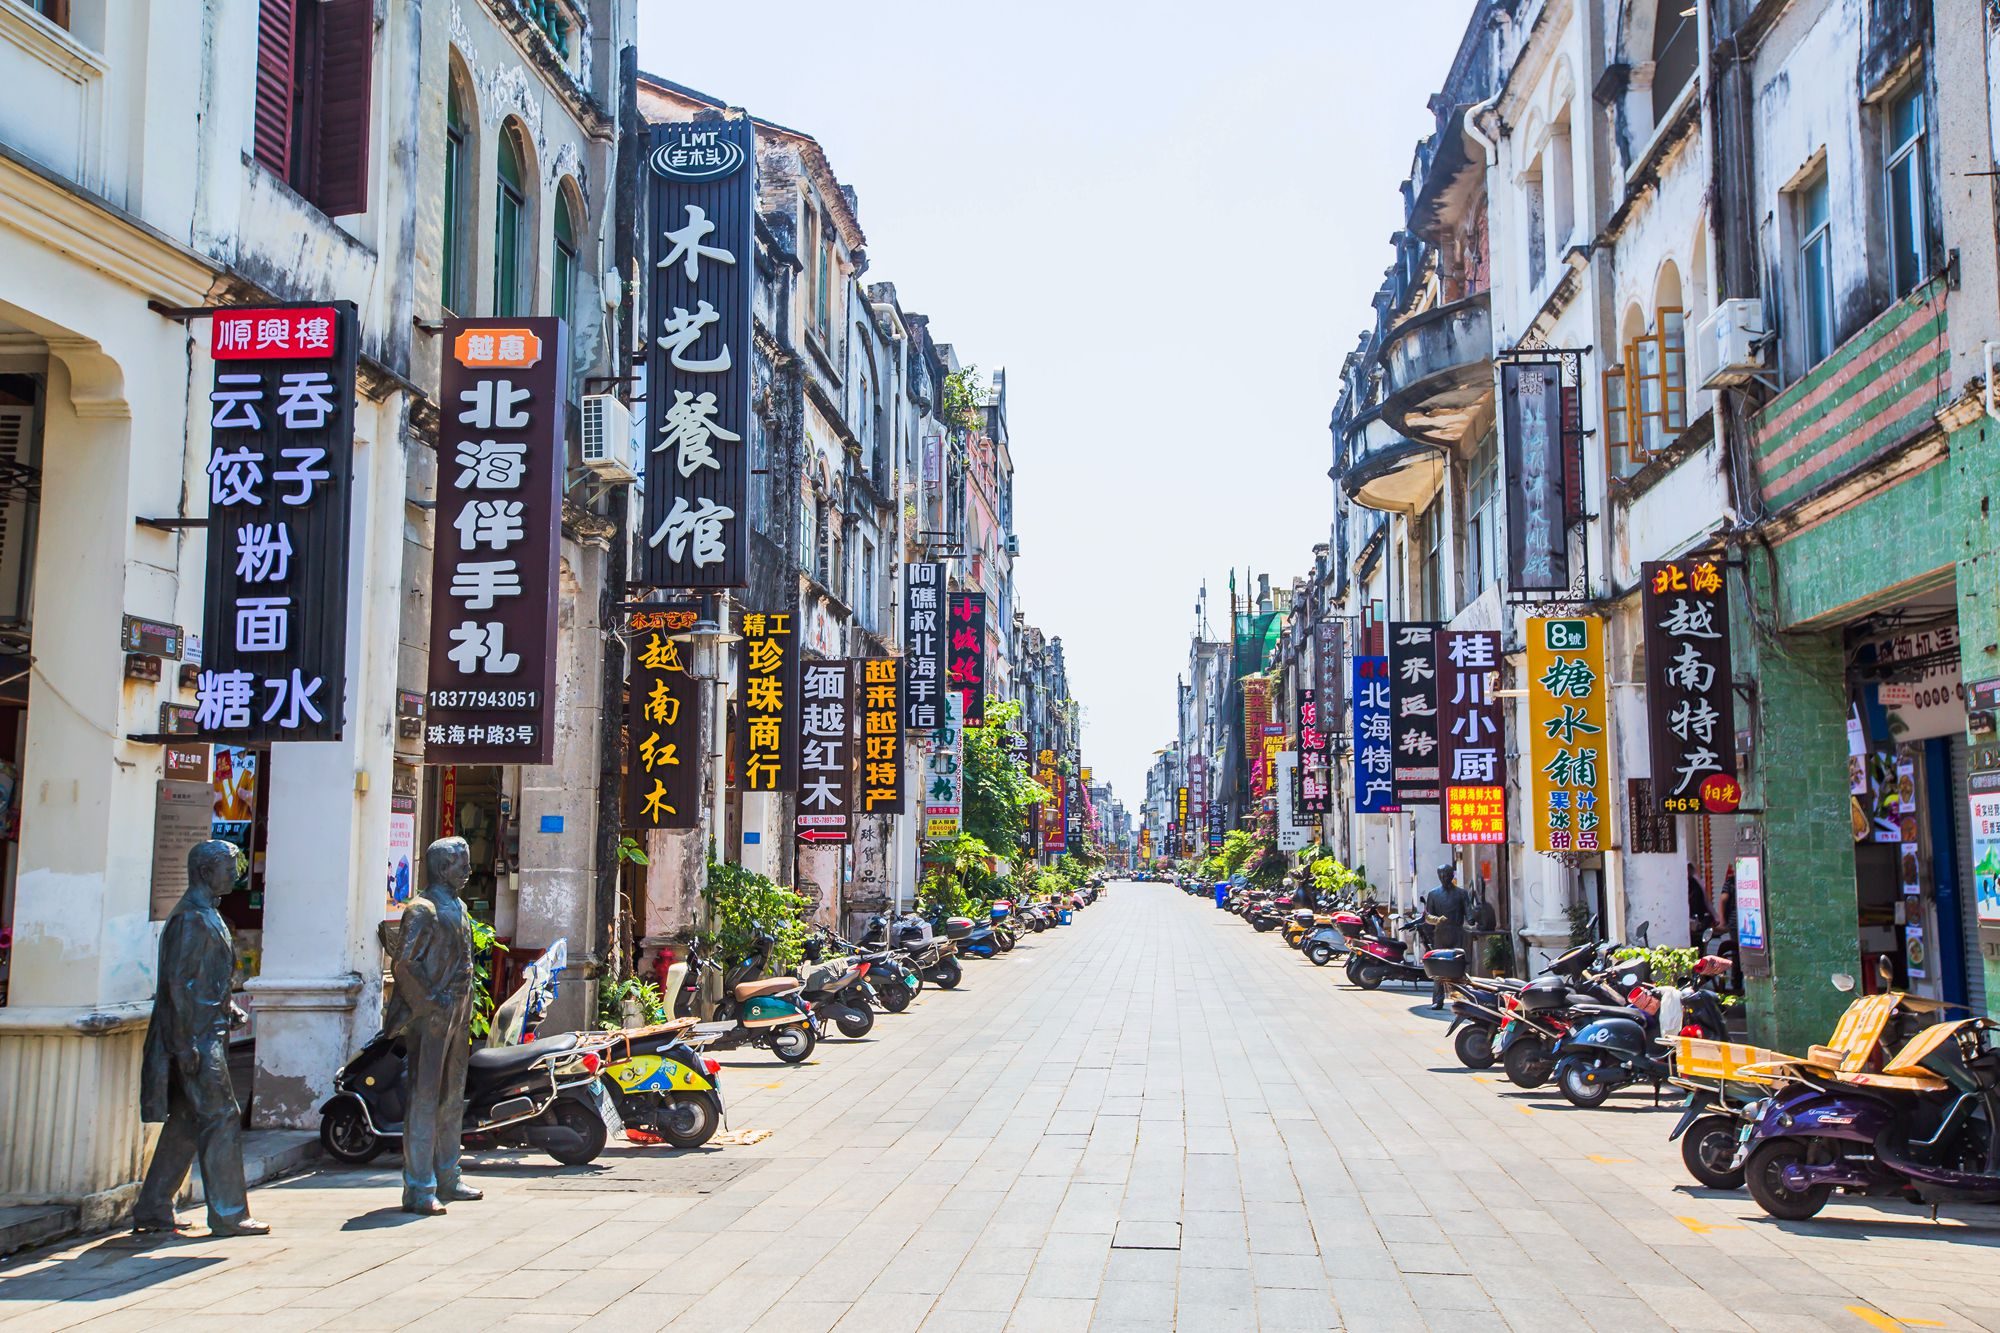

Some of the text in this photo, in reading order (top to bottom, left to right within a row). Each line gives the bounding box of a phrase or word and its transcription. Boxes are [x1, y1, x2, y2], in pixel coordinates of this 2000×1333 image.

[681, 132, 719, 147] LMT
[672, 147, 721, 166] 老木头
[217, 317, 330, 349] 順興樓
[466, 334, 526, 363] 越惠
[209, 372, 334, 430] 云吞
[649, 204, 741, 570] 木艺餐馆
[206, 446, 330, 507] 饺子
[447, 379, 531, 674] 北海伴手礼
[1652, 562, 1724, 595] 北海
[742, 613, 792, 637] 精工
[908, 562, 938, 727] 阿礁叔北海手信
[194, 667, 324, 730] 糖水
[430, 691, 536, 707] 18377943051
[746, 637, 784, 789] 珍珠商行
[1448, 634, 1498, 783] 桂川小厨
[1658, 598, 1723, 797] 越南特产
[427, 724, 535, 745] 珠海中路3号
[637, 632, 685, 825] 越南红木
[801, 665, 846, 811] 缅越红木
[865, 660, 897, 811] 越来越好特产
[1360, 681, 1392, 806] 北海特产
[1450, 803, 1503, 817] 海鲜加工
[1548, 791, 1599, 811] 果汁
[1664, 798, 1701, 812] 中6号
[1704, 783, 1739, 804] 阳光
[1549, 811, 1599, 831] 冰沙
[1550, 831, 1600, 851] 甜品
